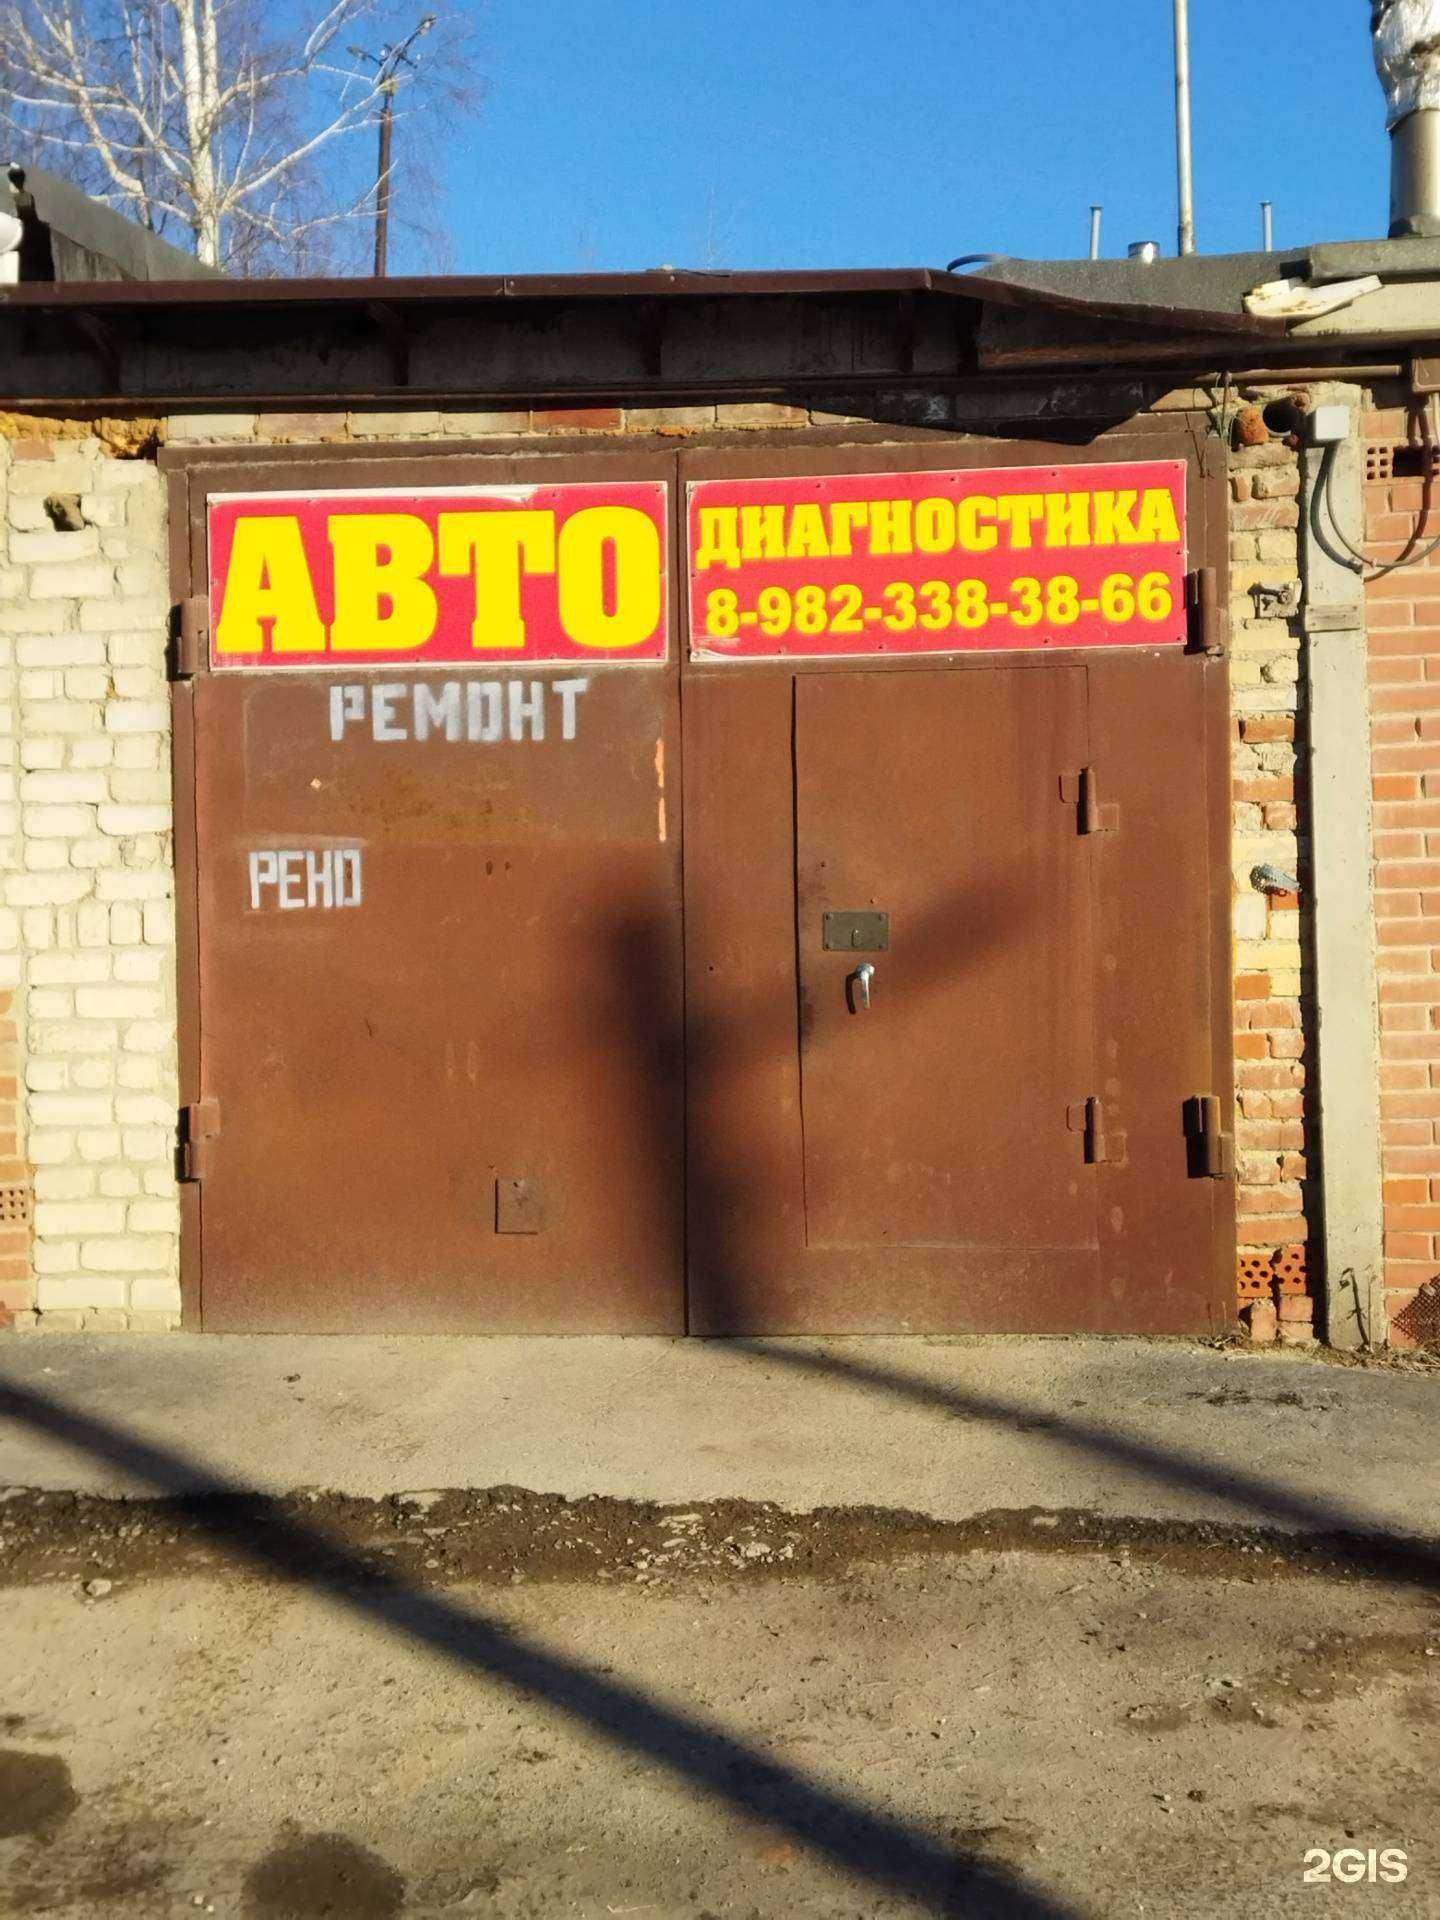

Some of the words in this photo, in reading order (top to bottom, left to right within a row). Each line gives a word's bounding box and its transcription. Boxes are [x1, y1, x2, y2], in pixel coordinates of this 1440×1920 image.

[696, 487, 1181, 570] ДИАГНОСТИКА
[216, 506, 662, 653] АВТО
[706, 571, 1172, 637] 8-982-338-38-66
[329, 678, 588, 742] РЕМОНТ
